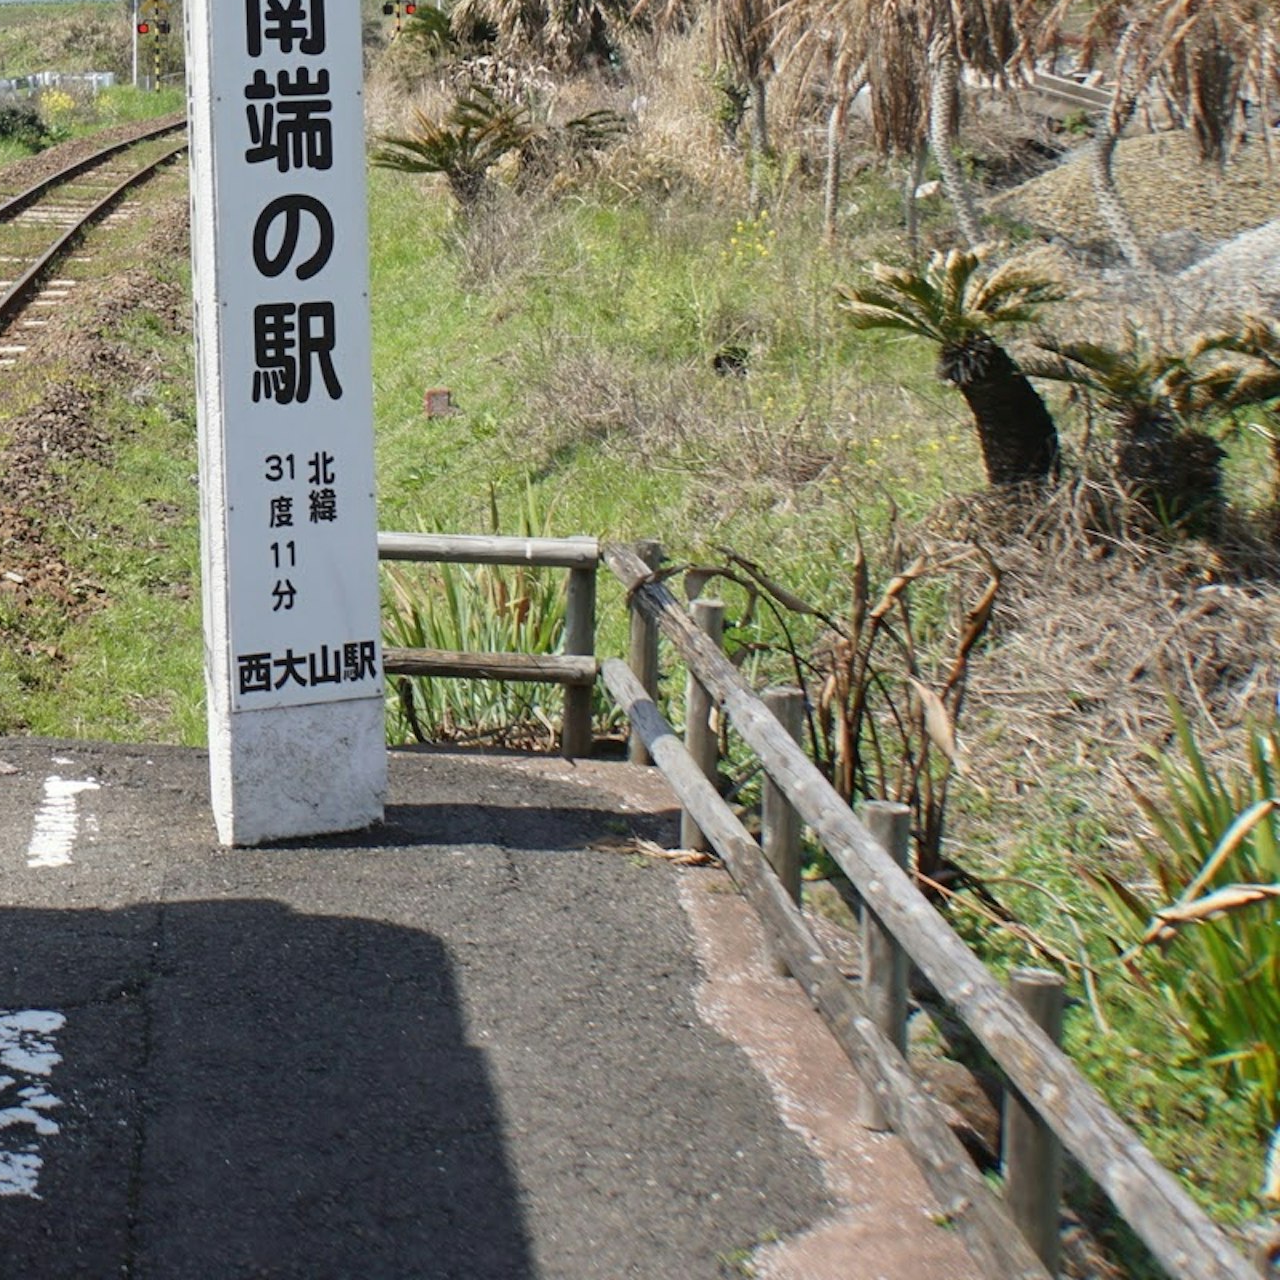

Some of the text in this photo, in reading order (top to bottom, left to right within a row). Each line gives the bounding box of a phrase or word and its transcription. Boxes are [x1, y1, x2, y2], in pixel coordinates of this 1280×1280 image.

[308, 451, 338, 524] 北緯
[237, 640, 377, 695] 西大山駅
